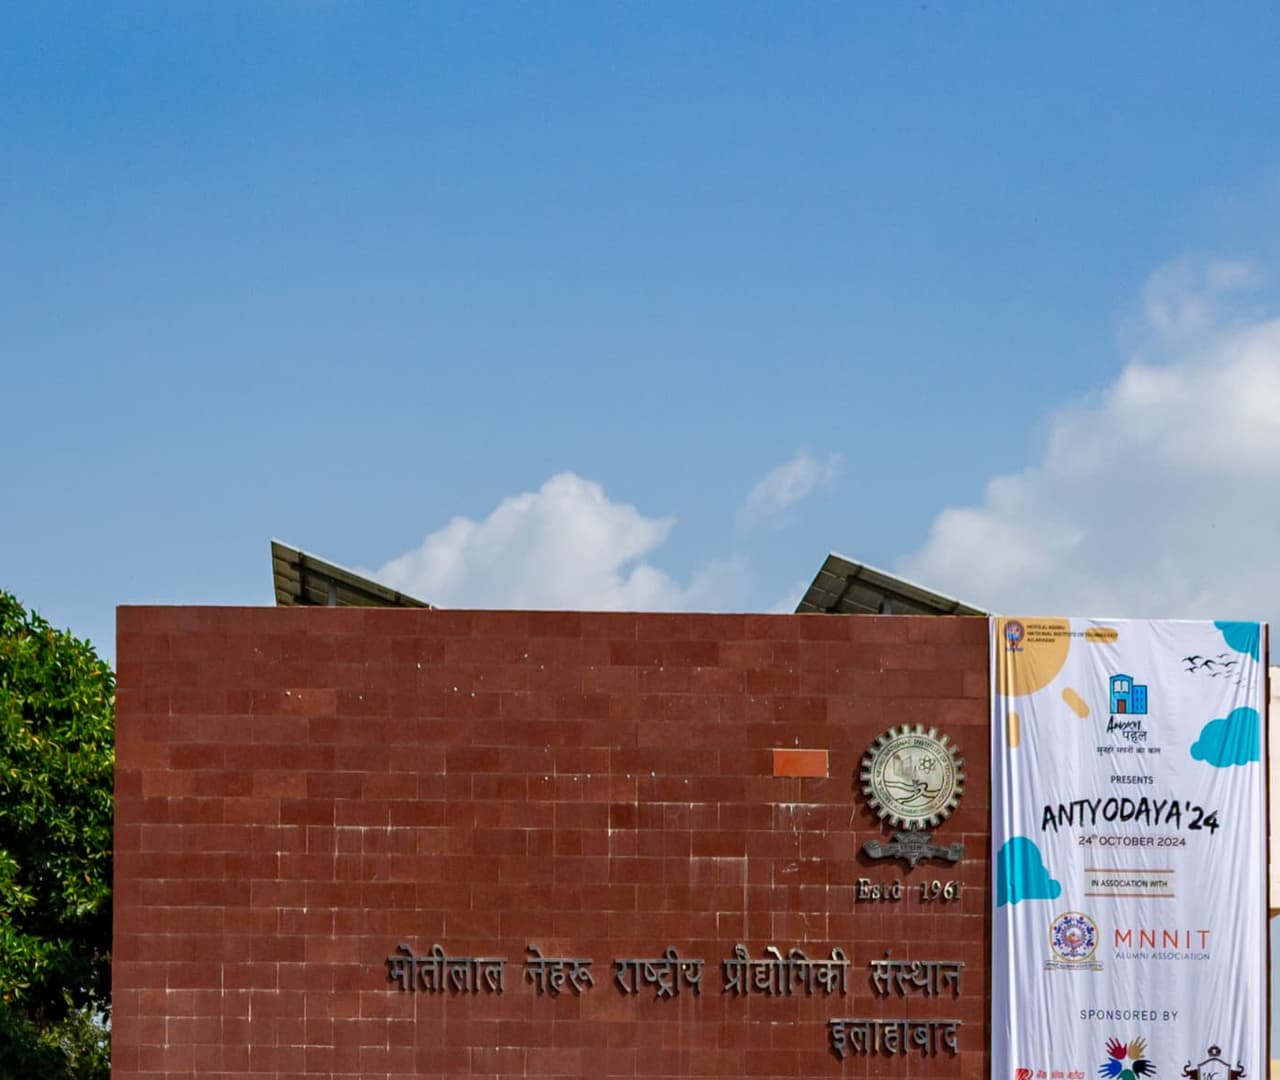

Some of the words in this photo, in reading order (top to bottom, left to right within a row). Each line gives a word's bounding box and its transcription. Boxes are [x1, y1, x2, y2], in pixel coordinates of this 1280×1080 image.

[1122, 731, 1147, 744] पहल
[1110, 775, 1154, 785] PRESENTS
[1042, 797, 1220, 835] ANTYODAYA'24
[1099, 836, 1154, 847] OCTOBER
[1157, 837, 1186, 847] 2024
[857, 878, 902, 901] Estd
[921, 878, 962, 901] 1961
[1091, 880, 1099, 888] IN
[1101, 880, 1148, 888] ASSOCIATION
[1150, 880, 1168, 888] WITH
[1114, 929, 1211, 949] MNNIT
[1115, 952, 1149, 961] ALUMNI
[1151, 952, 1211, 961] ASSOCIATION
[386, 943, 507, 992] मोतीलाल
[523, 944, 596, 993] नेहरू
[613, 945, 704, 999] राष्ट्रीय
[721, 943, 850, 995] प्रौद्योगिकी
[869, 948, 965, 997] संस्थान
[1080, 1009, 1157, 1021] SPONSORED
[1163, 1010, 1179, 1021] BY
[828, 1017, 965, 1059] इलाहाबाद
